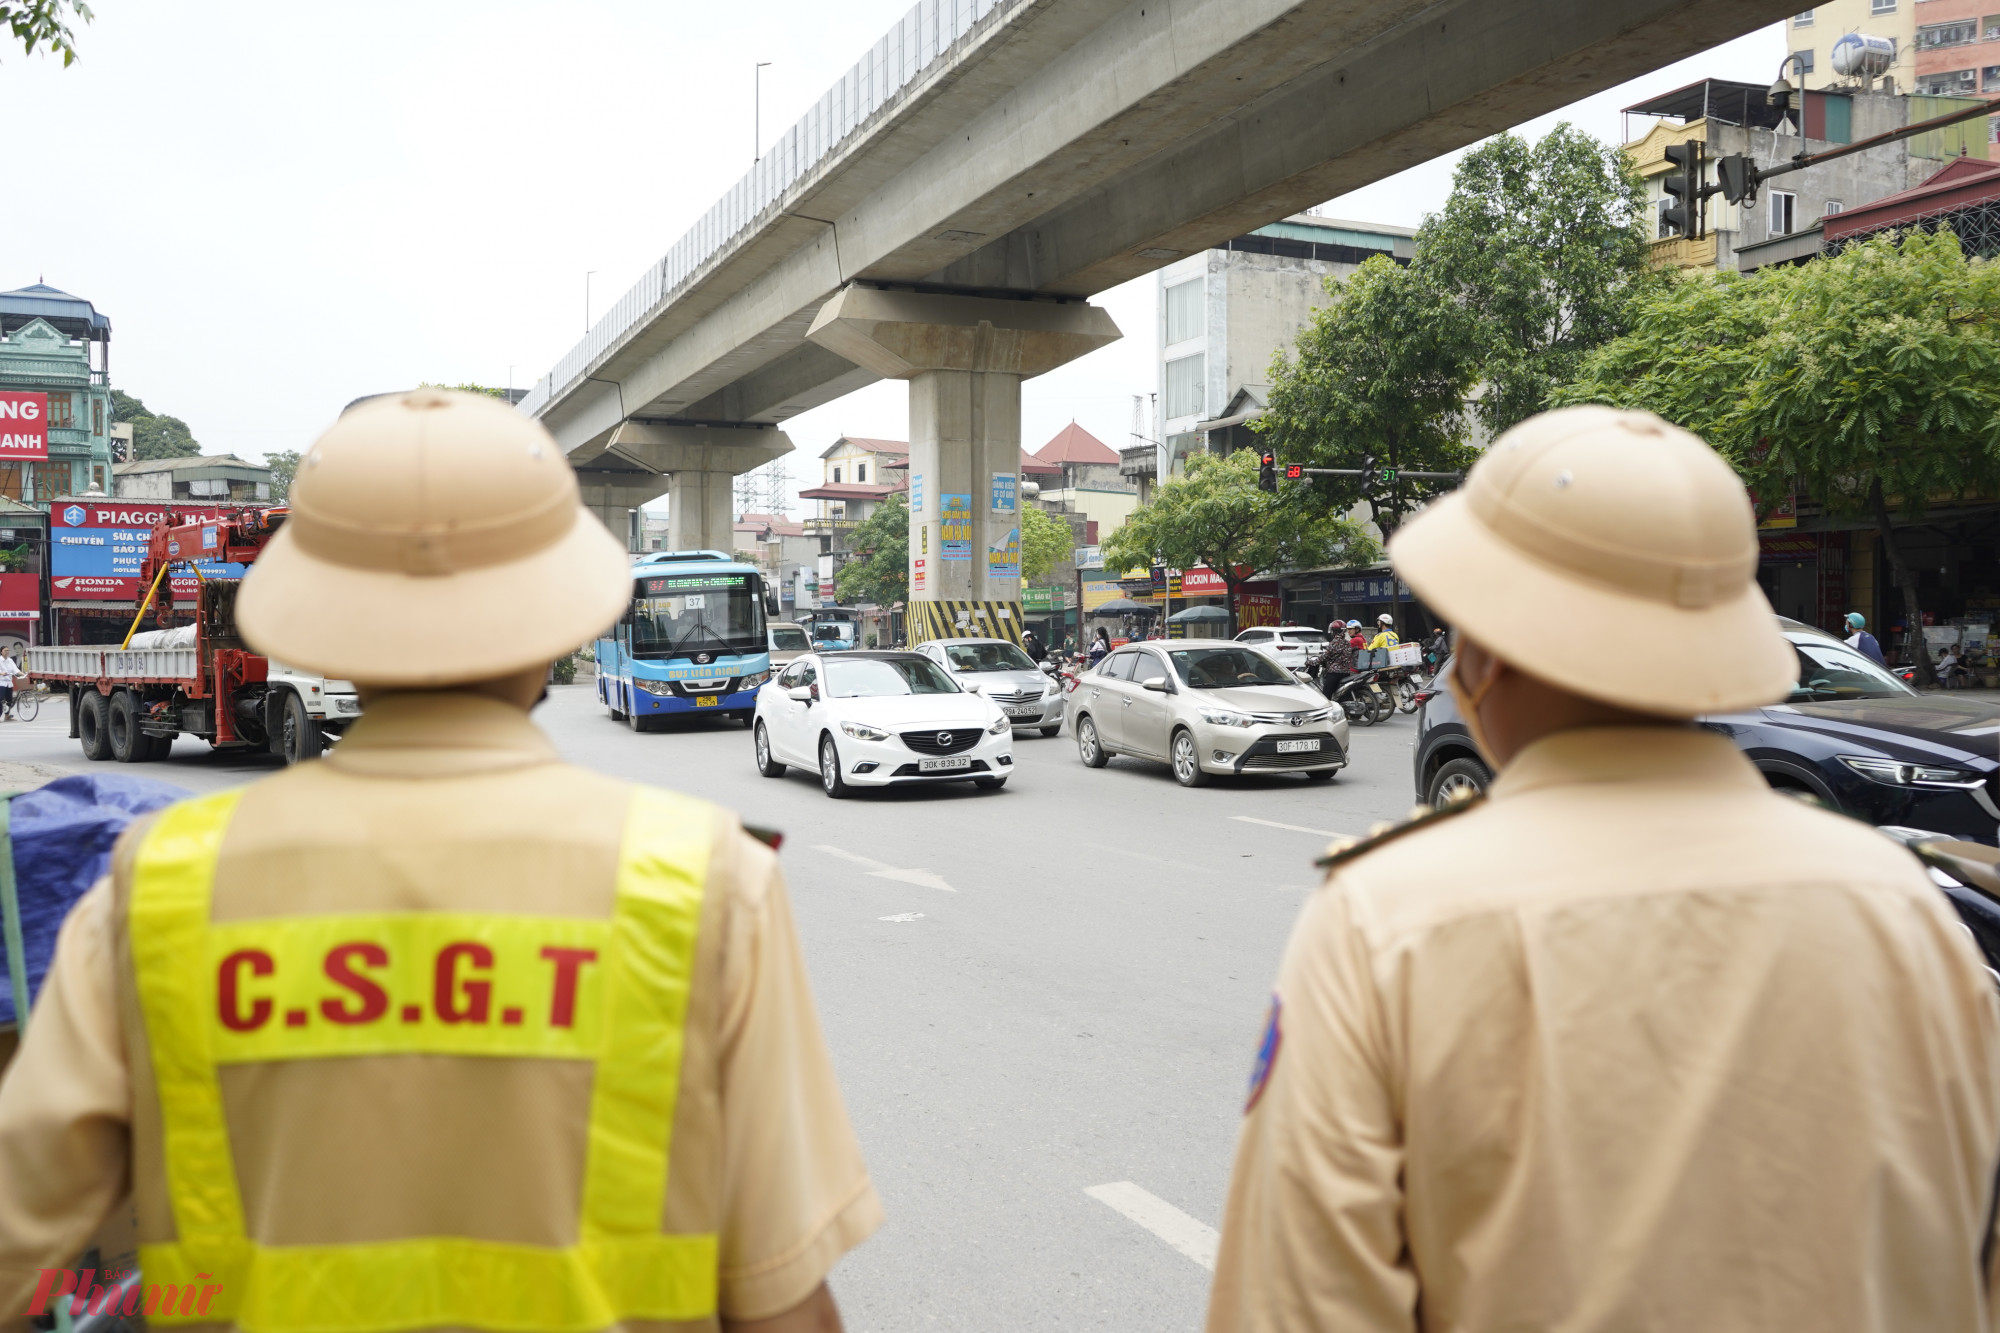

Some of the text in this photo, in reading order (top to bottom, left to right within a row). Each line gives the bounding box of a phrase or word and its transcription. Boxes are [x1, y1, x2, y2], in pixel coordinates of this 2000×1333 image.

[0, 433, 42, 449] ANH
[1287, 466, 1301, 478] 68
[1383, 469, 1395, 481] 37
[96, 511, 176, 525] PIAGGI
[1185, 574, 1209, 585] LUCKIN
[690, 598, 701, 607] 37
[1278, 740, 1319, 752] 30F-178.12
[924, 758, 968, 769] 30K-839.32
[216, 941, 599, 1032] C.S.G.T
